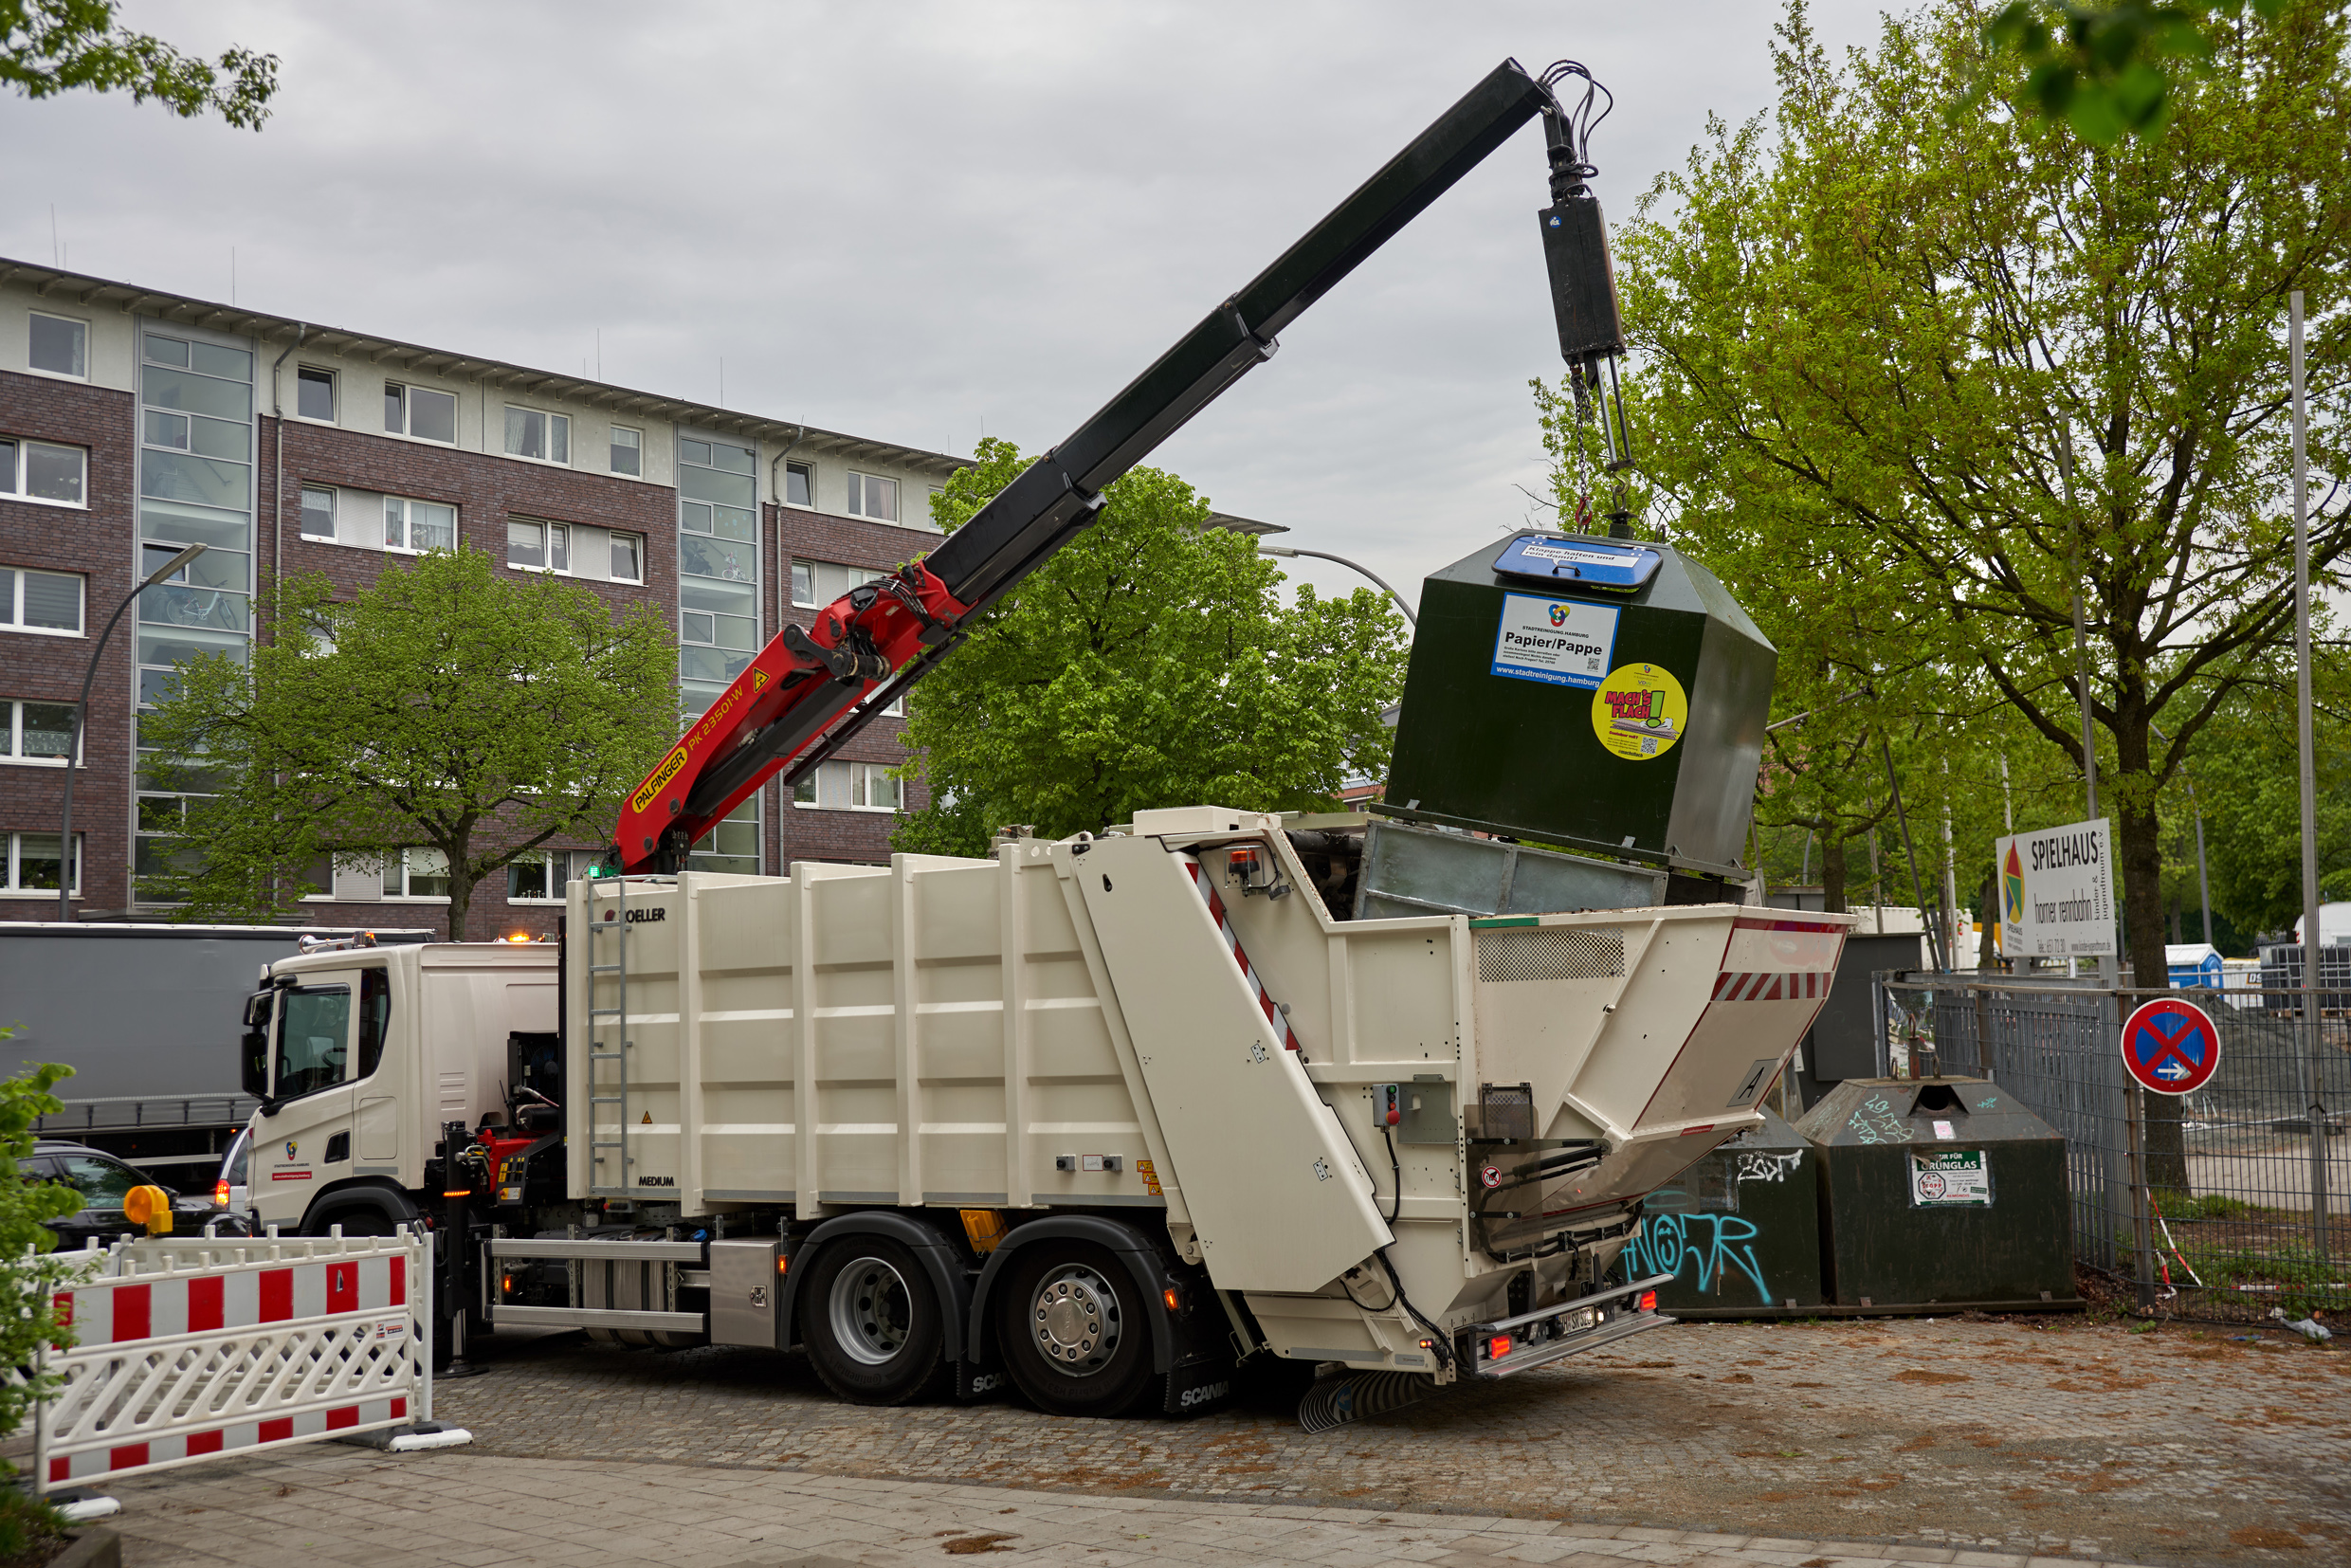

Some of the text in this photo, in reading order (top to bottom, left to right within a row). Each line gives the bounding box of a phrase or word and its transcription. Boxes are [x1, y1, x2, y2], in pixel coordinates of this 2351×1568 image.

[1528, 546, 1561, 555] Klappe
[1546, 553, 1578, 561] damit!
[1504, 631, 1603, 656] Papier/Pappe
[1496, 666, 1600, 687] www.stadtreinigung.hamburg
[1604, 689, 1652, 705] MACH'S
[687, 731, 703, 751] PK
[635, 751, 685, 810] PALFINGER
[2032, 830, 2099, 871] SPIELHAUS
[2099, 852, 2109, 921] jugendtraum
[2033, 887, 2093, 924] horner rennbahn
[2091, 875, 2101, 921] kinder &
[618, 907, 665, 923] OELLER
[1738, 1067, 1765, 1099] A
[1921, 1160, 1977, 1171] GRÜNGLAS
[1949, 1152, 1963, 1160] FÜR
[638, 1176, 675, 1187] MEDIUM
[1180, 1380, 1230, 1408] SCANIA
